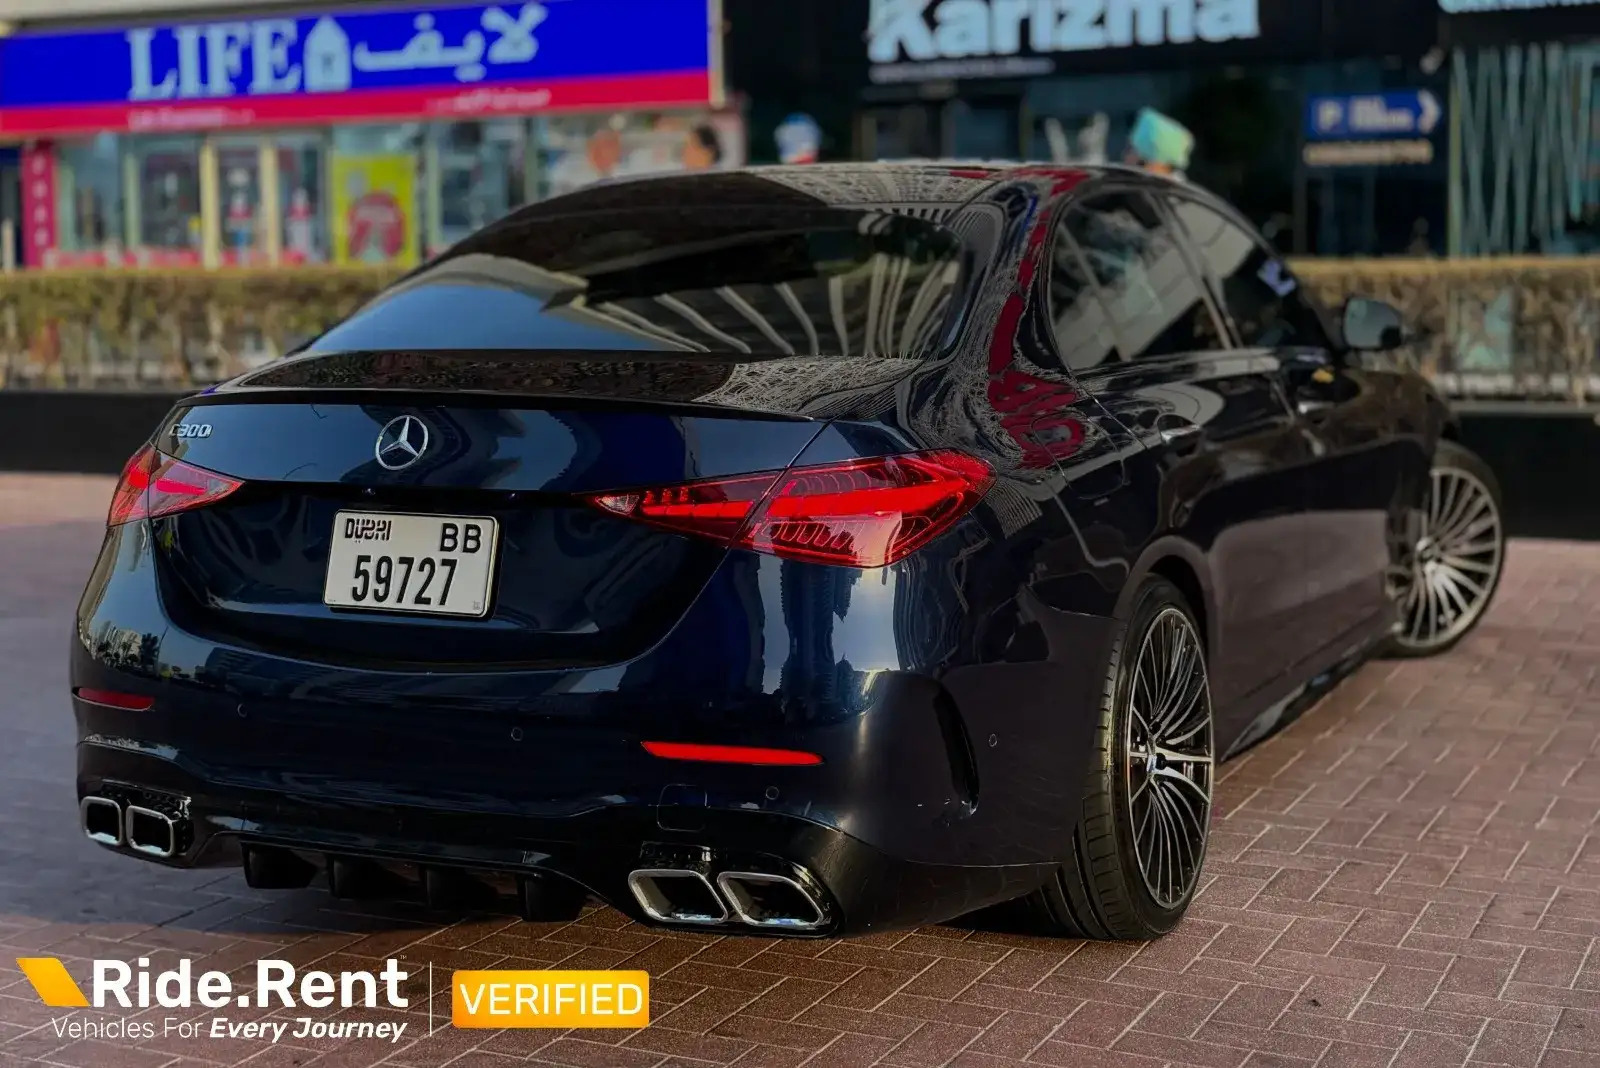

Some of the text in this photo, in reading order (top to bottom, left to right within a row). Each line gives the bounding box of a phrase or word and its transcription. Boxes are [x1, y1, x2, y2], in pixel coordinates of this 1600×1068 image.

[125, 17, 302, 101] LIFE
[353, 2, 548, 82] لايف
[867, 0, 1260, 63] Karizma
[440, 522, 482, 553] BB
[352, 555, 457, 606] 59727
